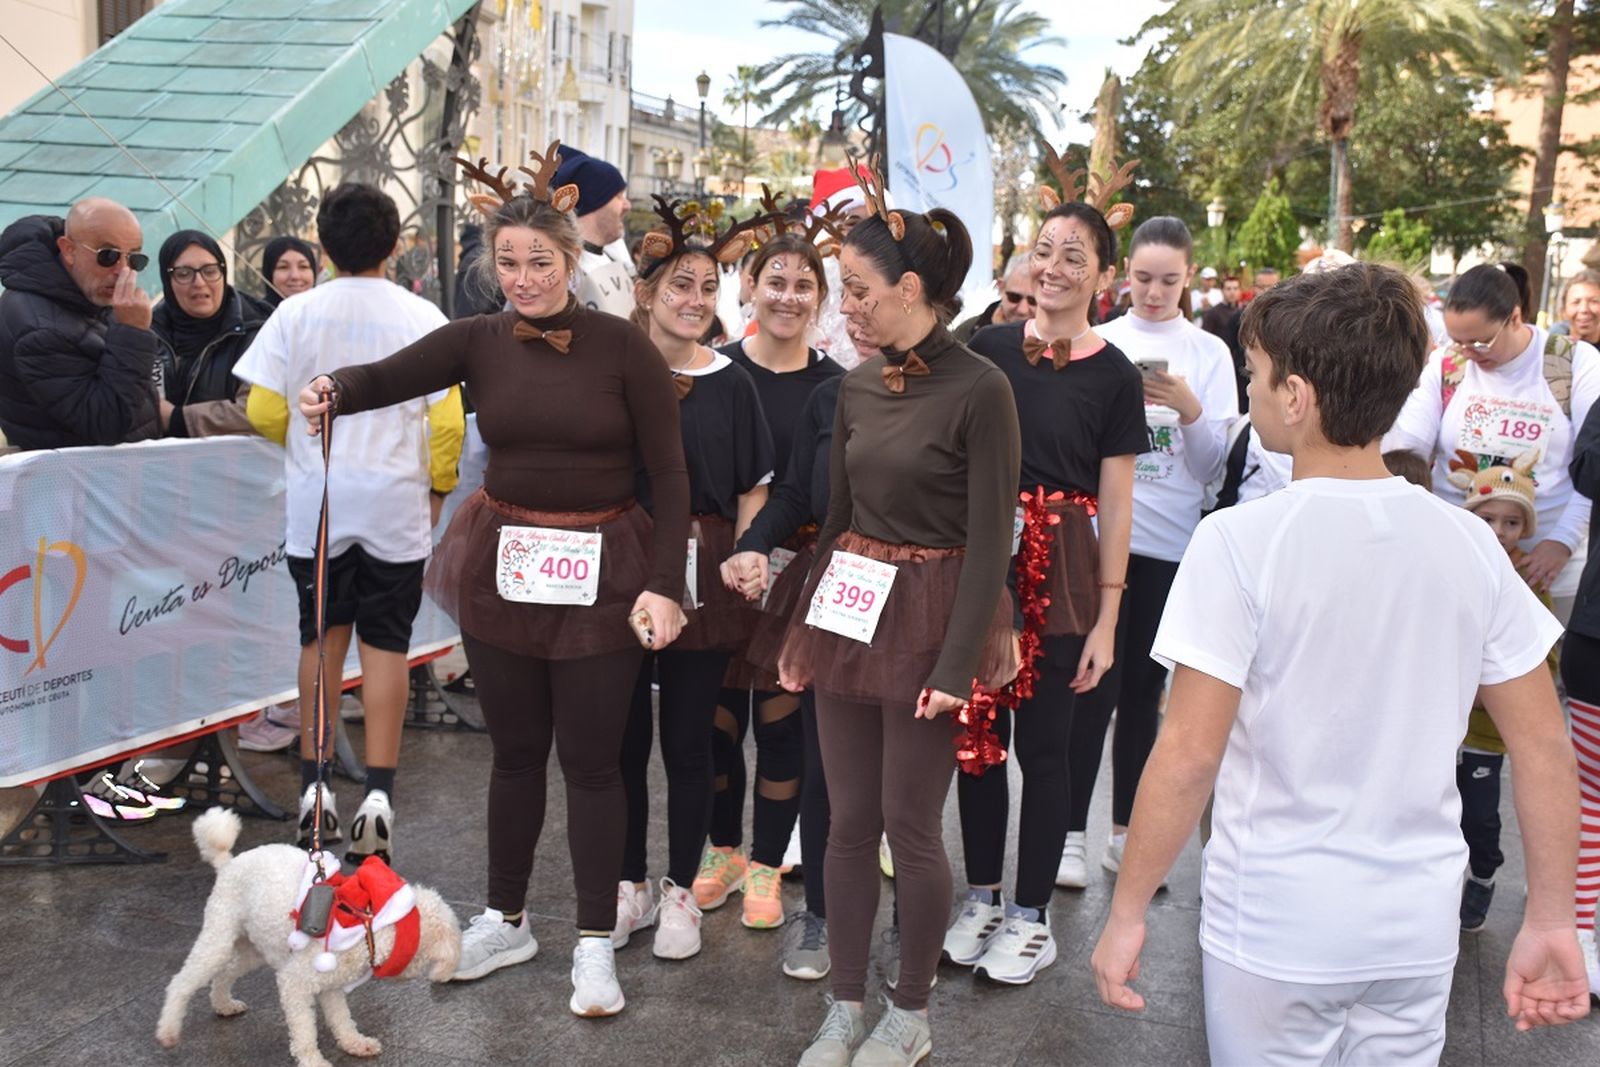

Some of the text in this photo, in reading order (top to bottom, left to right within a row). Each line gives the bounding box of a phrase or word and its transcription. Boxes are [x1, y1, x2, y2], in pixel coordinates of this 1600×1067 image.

[1497, 419, 1542, 441] 189
[539, 556, 589, 581] 400
[119, 540, 287, 635] Ceuta es Deport
[832, 581, 875, 612] 399
[27, 682, 42, 697] DE
[43, 669, 93, 692] DEPORTES
